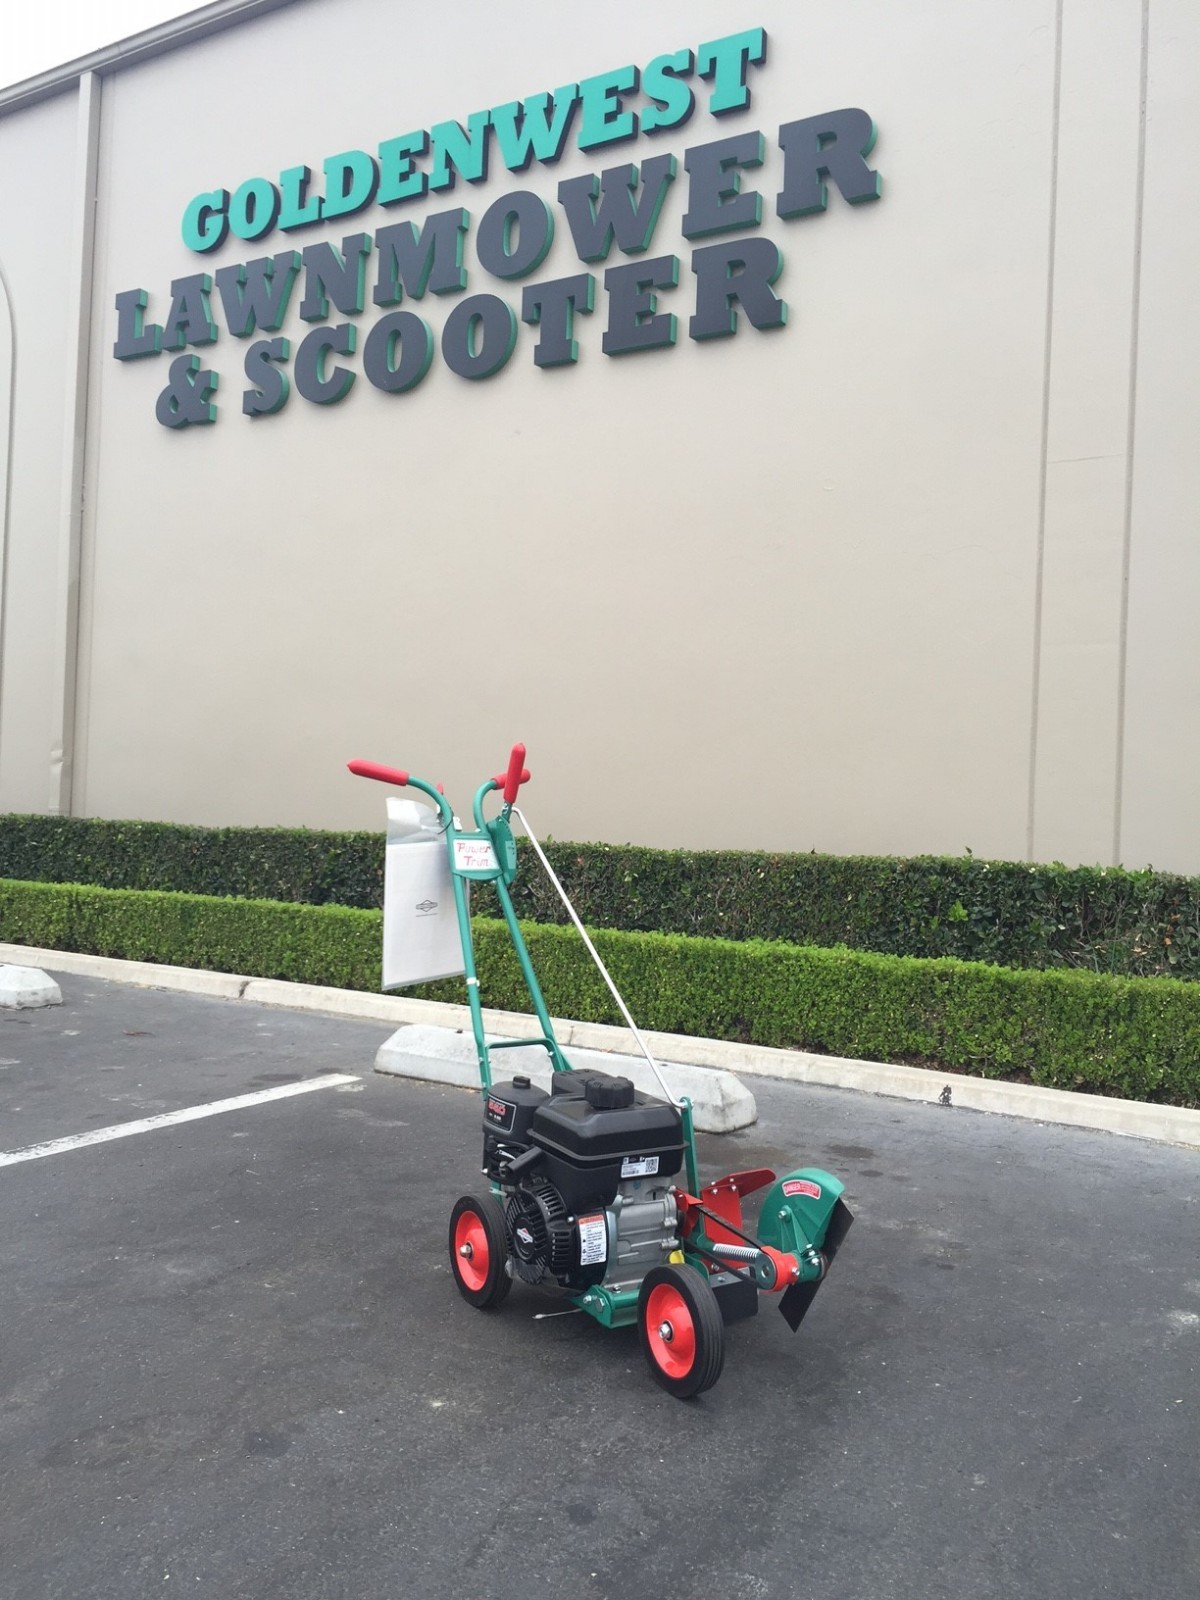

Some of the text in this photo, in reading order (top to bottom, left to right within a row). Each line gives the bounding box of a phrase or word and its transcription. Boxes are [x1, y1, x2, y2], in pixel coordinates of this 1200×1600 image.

[114, 108, 882, 361] LAWNMOWER
[182, 27, 768, 252] GOLDENWEST
[156, 239, 789, 429] & SCOOTER
[457, 842, 491, 853] Power
[464, 855, 489, 867] Trim
